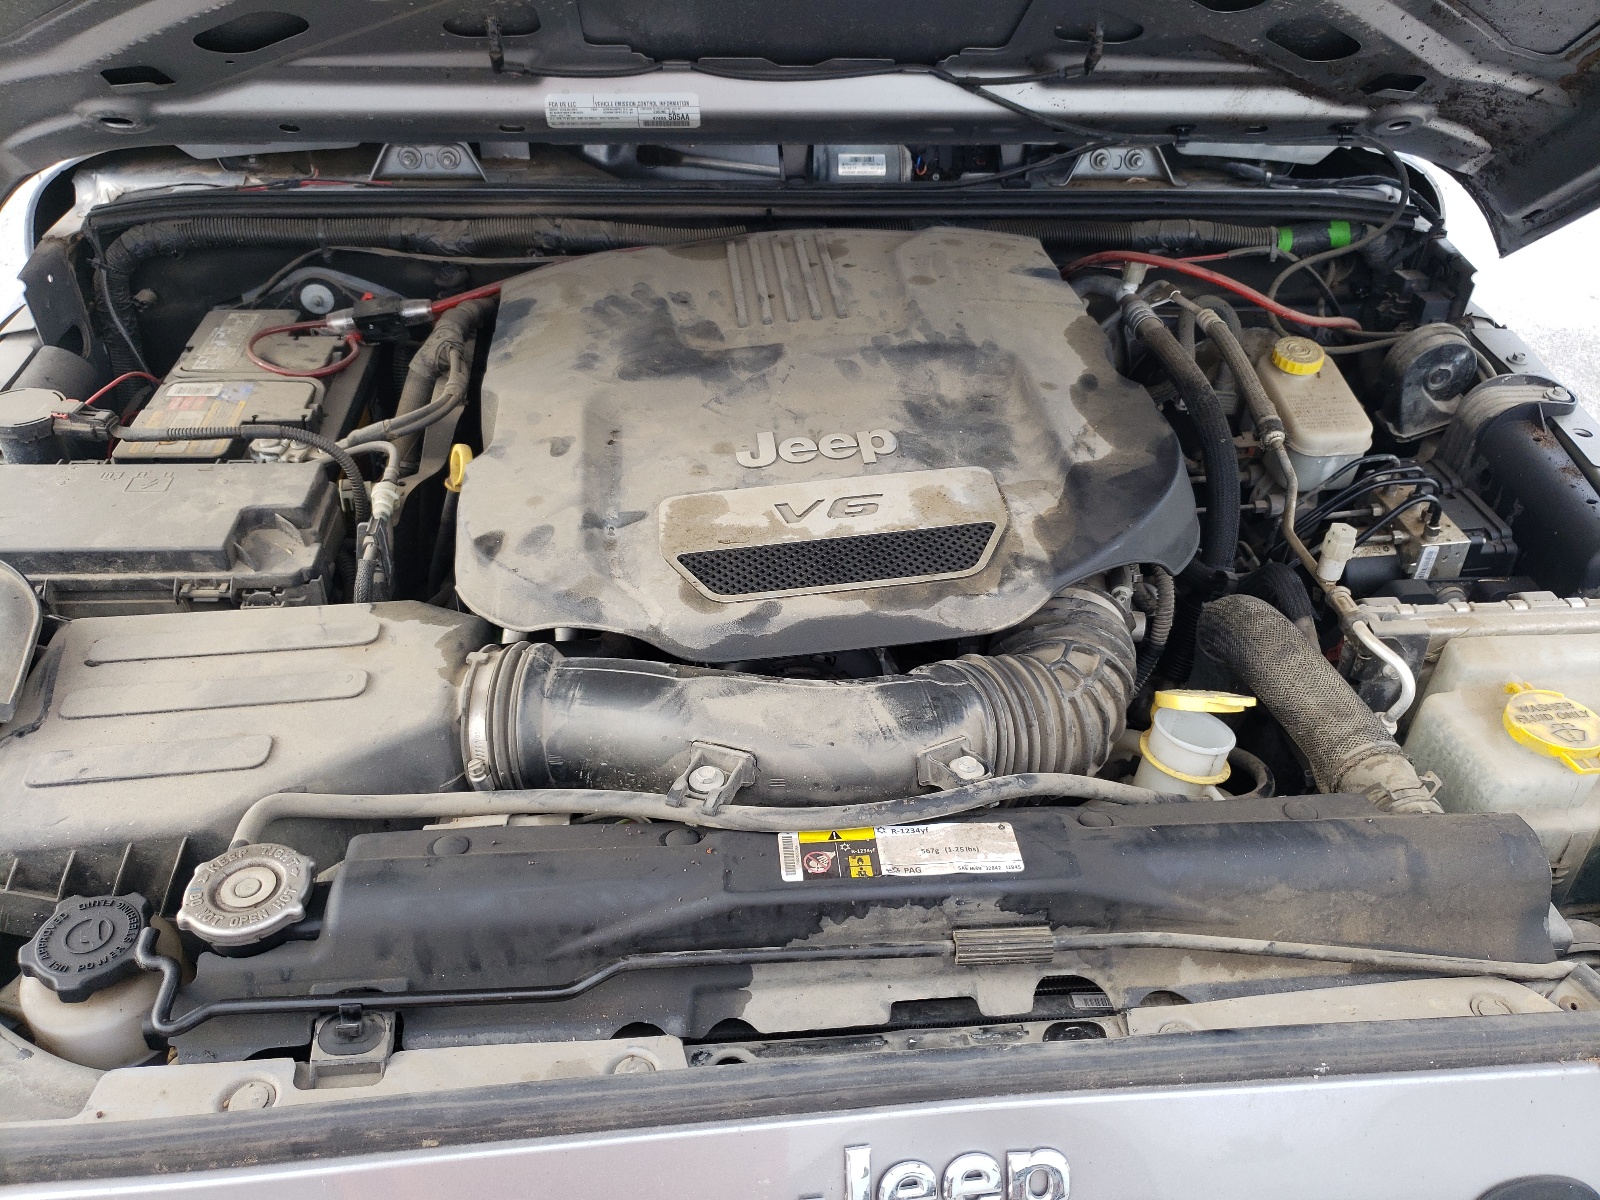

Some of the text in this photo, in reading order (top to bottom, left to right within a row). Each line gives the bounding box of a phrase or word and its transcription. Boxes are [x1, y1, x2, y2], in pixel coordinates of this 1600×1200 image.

[668, 113, 690, 121] 505AA
[735, 428, 898, 469] Jeep
[774, 493, 883, 524] V6
[1515, 702, 1575, 713] WASHER
[1514, 709, 1590, 724] FLUID ONLY
[891, 826, 929, 835] R-1234yf
[850, 847, 876, 855] R-1234yf
[921, 847, 940, 855] 567g
[206, 845, 301, 873] KEEP TIGHT
[903, 866, 922, 874] PAG
[78, 899, 116, 911] FLUID
[195, 907, 226, 926] NOT
[229, 908, 270, 927] OPEN
[272, 885, 298, 910] HOT
[116, 902, 139, 944] STEERING
[38, 912, 69, 960] APPROVED
[77, 946, 126, 973] POWER
